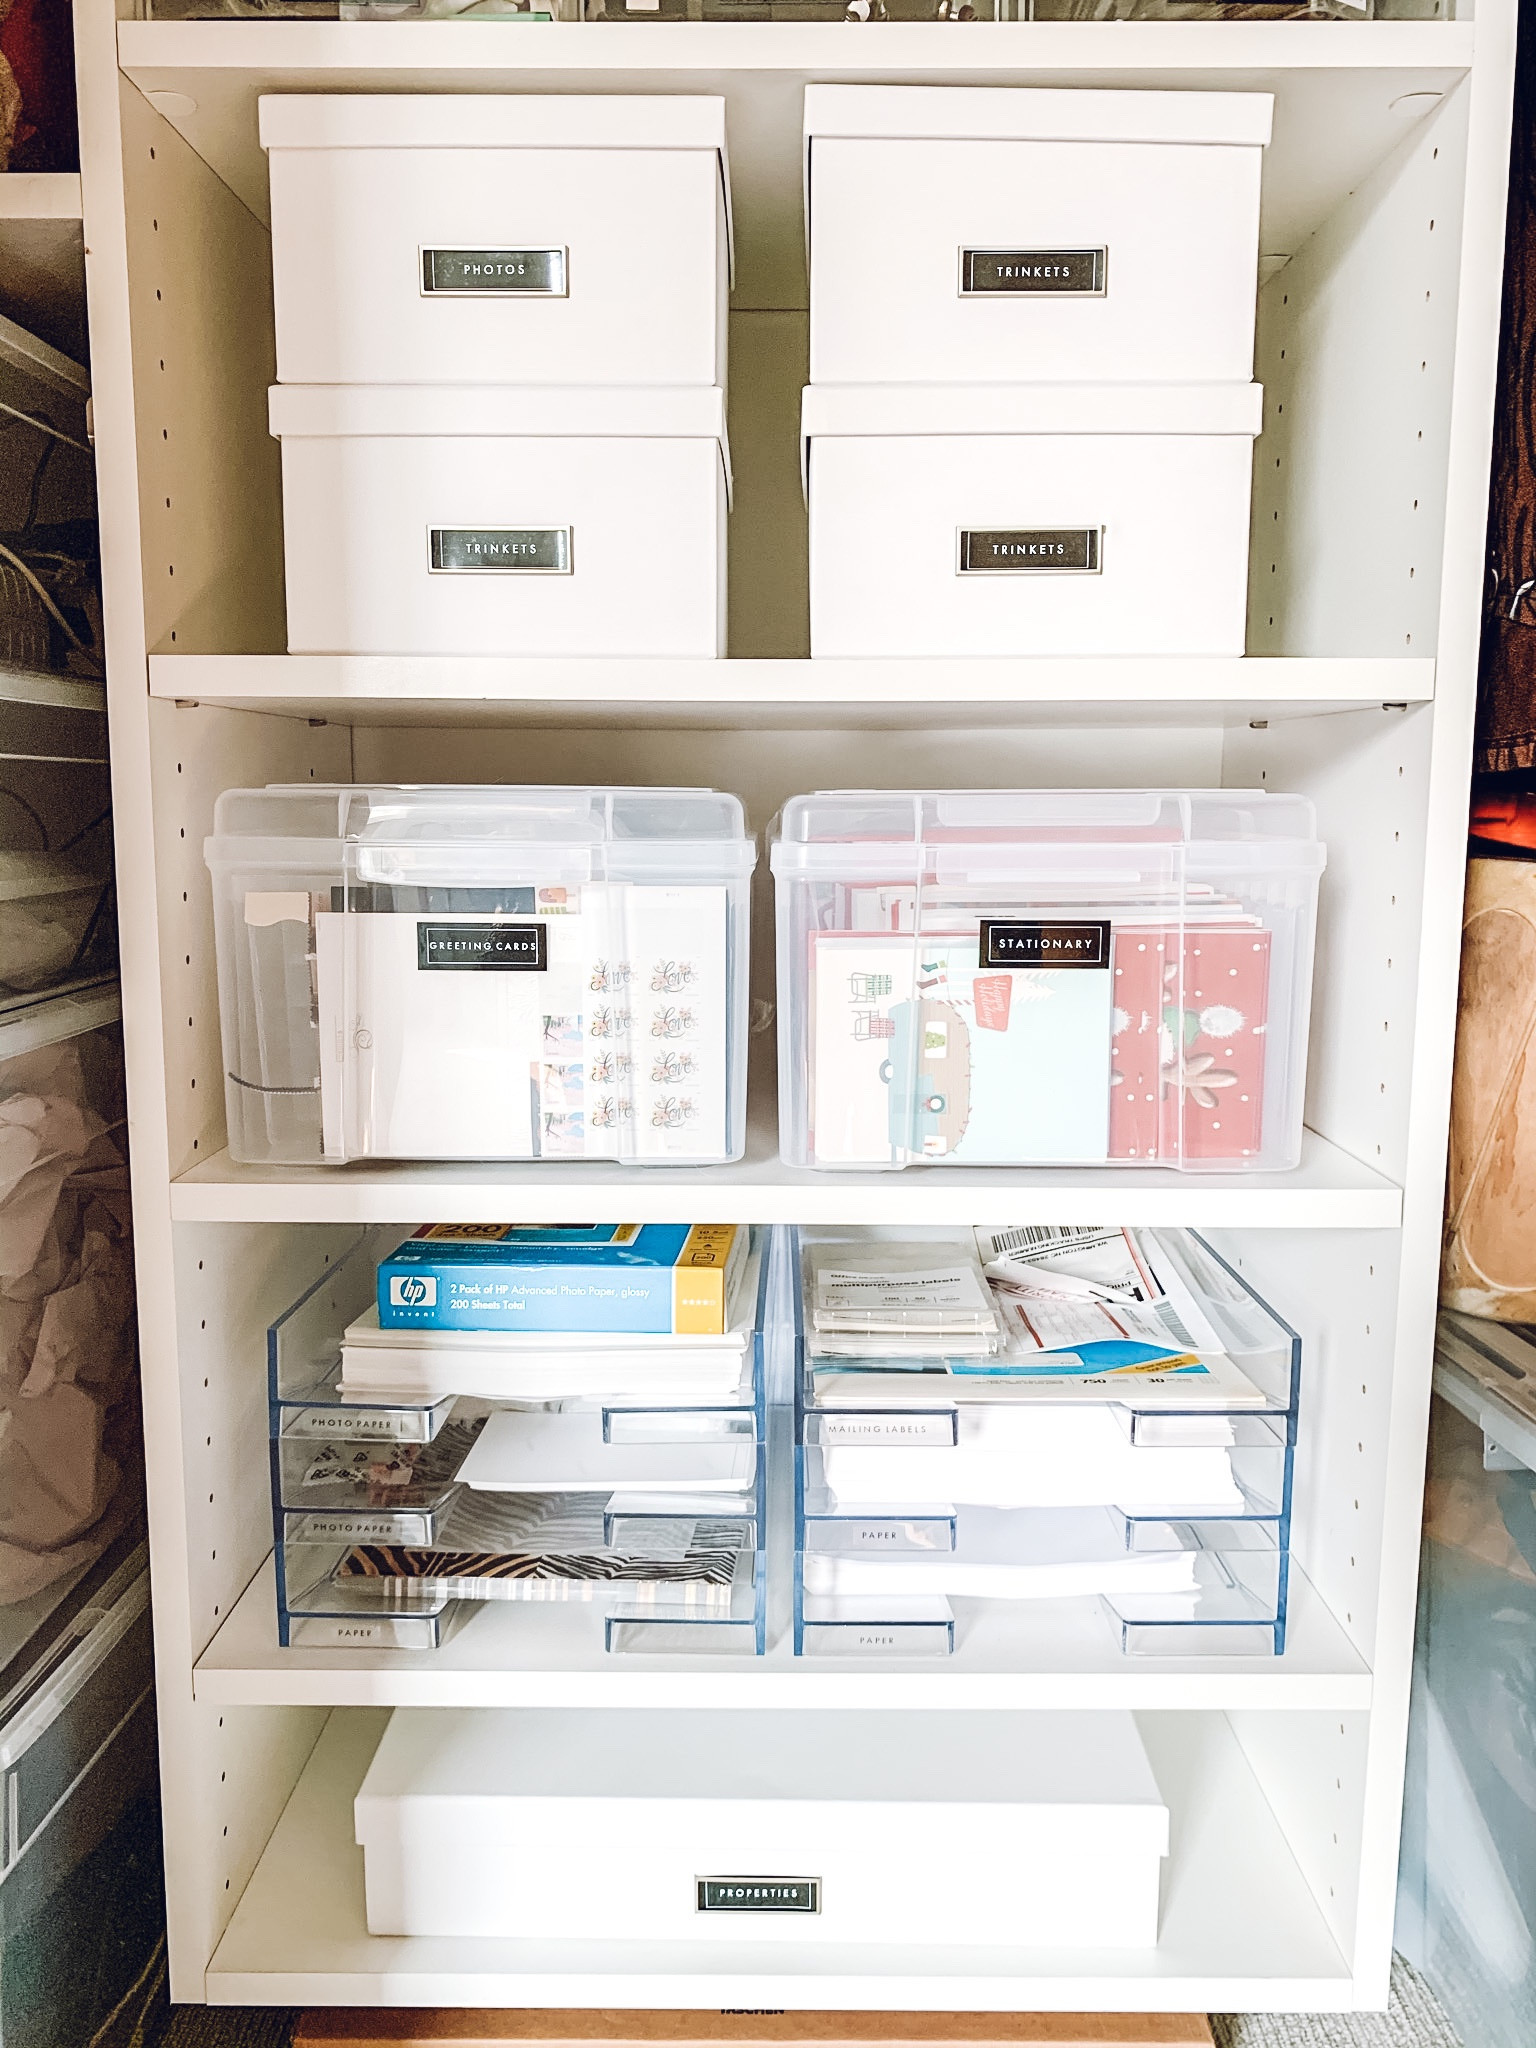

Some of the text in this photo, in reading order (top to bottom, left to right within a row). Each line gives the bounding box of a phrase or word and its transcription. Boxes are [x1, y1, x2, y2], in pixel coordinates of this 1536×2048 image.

[463, 264, 526, 275] PHOTOS
[996, 266, 1070, 277] TRINKETS
[465, 543, 537, 554] TRINKETS
[992, 543, 1065, 555] TRINKETS
[428, 941, 537, 951] GREETING CARDS
[998, 938, 1093, 949] STATIONARY
[443, 1224, 502, 1233] 200
[450, 1283, 650, 1299] 2 Pack of HP Advanced Photo Paper, glossy
[450, 1300, 526, 1310] 200 Sheets Total
[311, 1418, 391, 1429] PHOTO PAPER
[828, 1425, 927, 1434] MAILING LABELS
[313, 1523, 392, 1533] PHOTO PAPER
[862, 1531, 897, 1539] PAPER
[338, 1629, 372, 1637] PAPER
[860, 1636, 894, 1644] PAPER
[719, 1888, 798, 1898] PROPERTIES
